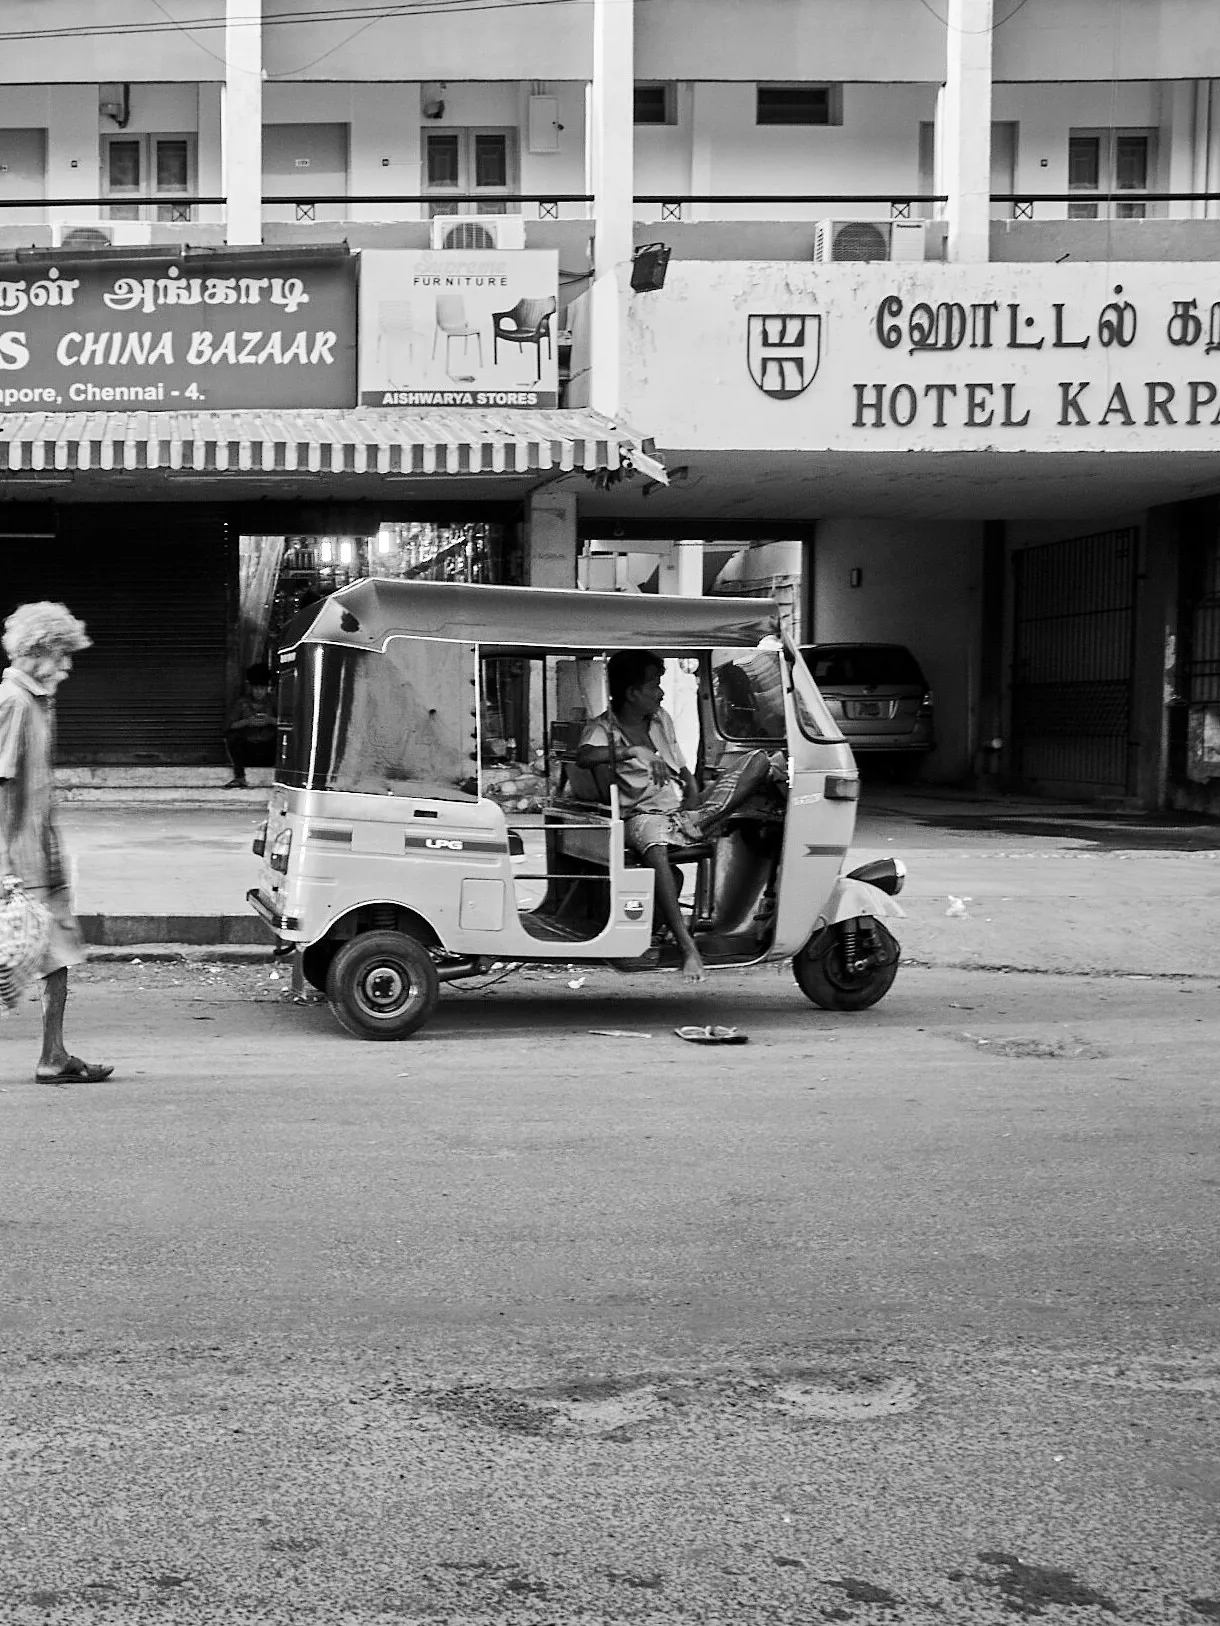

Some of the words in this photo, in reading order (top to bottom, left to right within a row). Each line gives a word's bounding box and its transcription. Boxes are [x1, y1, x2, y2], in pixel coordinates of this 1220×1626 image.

[103, 265, 310, 313] அங்காடி
[413, 277, 508, 287] FURNITURE
[876, 284, 1137, 357] ஹோட்டல்
[56, 331, 174, 366] CHINA
[186, 330, 337, 365] BAZAAR
[69, 383, 164, 401] Chennai
[184, 382, 206, 401] 4.
[382, 392, 473, 405] AISHWARYA
[476, 392, 538, 405] STORES
[852, 383, 1030, 428] HOTEL
[1057, 381, 1220, 427] KARP
[425, 838, 464, 850] LPG
